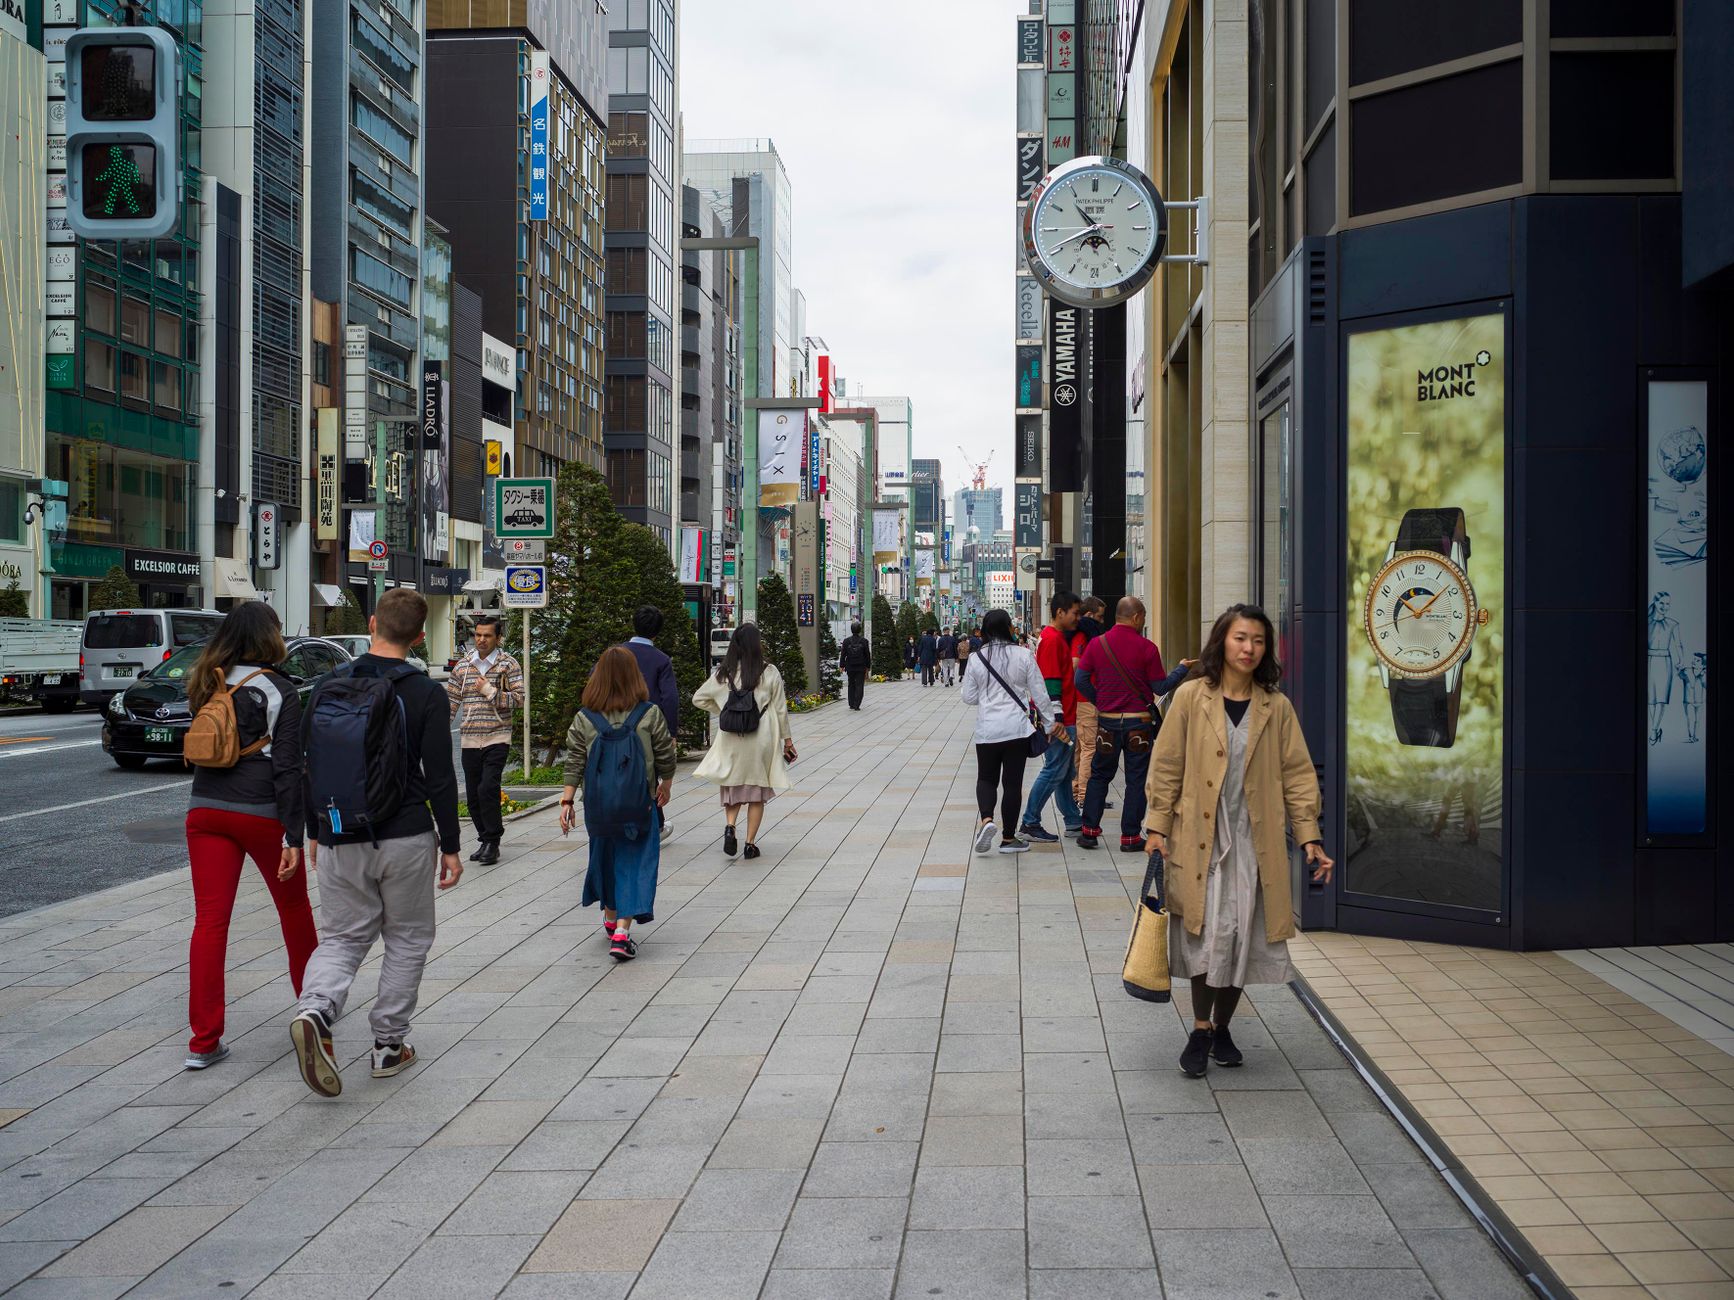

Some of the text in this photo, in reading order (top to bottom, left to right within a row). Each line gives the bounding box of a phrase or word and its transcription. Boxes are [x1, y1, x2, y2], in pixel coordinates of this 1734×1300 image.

[533, 117, 546, 205] 名鉄観光
[1090, 268, 1099, 279] 24
[1055, 308, 1075, 383] YAMAHA
[1418, 363, 1475, 384] MONT
[1418, 381, 1475, 402] BLANC
[424, 386, 439, 437] LLADRÓ
[263, 526, 271, 562] とらや
[134, 559, 200, 576] EXCELSIOR CAFFÉ
[1414, 564, 1425, 575] 12
[1435, 570, 1442, 580] 1
[1381, 584, 1391, 598] 10
[1447, 587, 1459, 598] 2
[1376, 608, 1385, 617] 9
[1452, 610, 1463, 620] 3
[1380, 630, 1389, 640] 8
[1447, 631, 1457, 642] 4
[1394, 646, 1403, 657] 7
[1432, 647, 1440, 659] 5
[151, 731, 172, 743] 98-11
